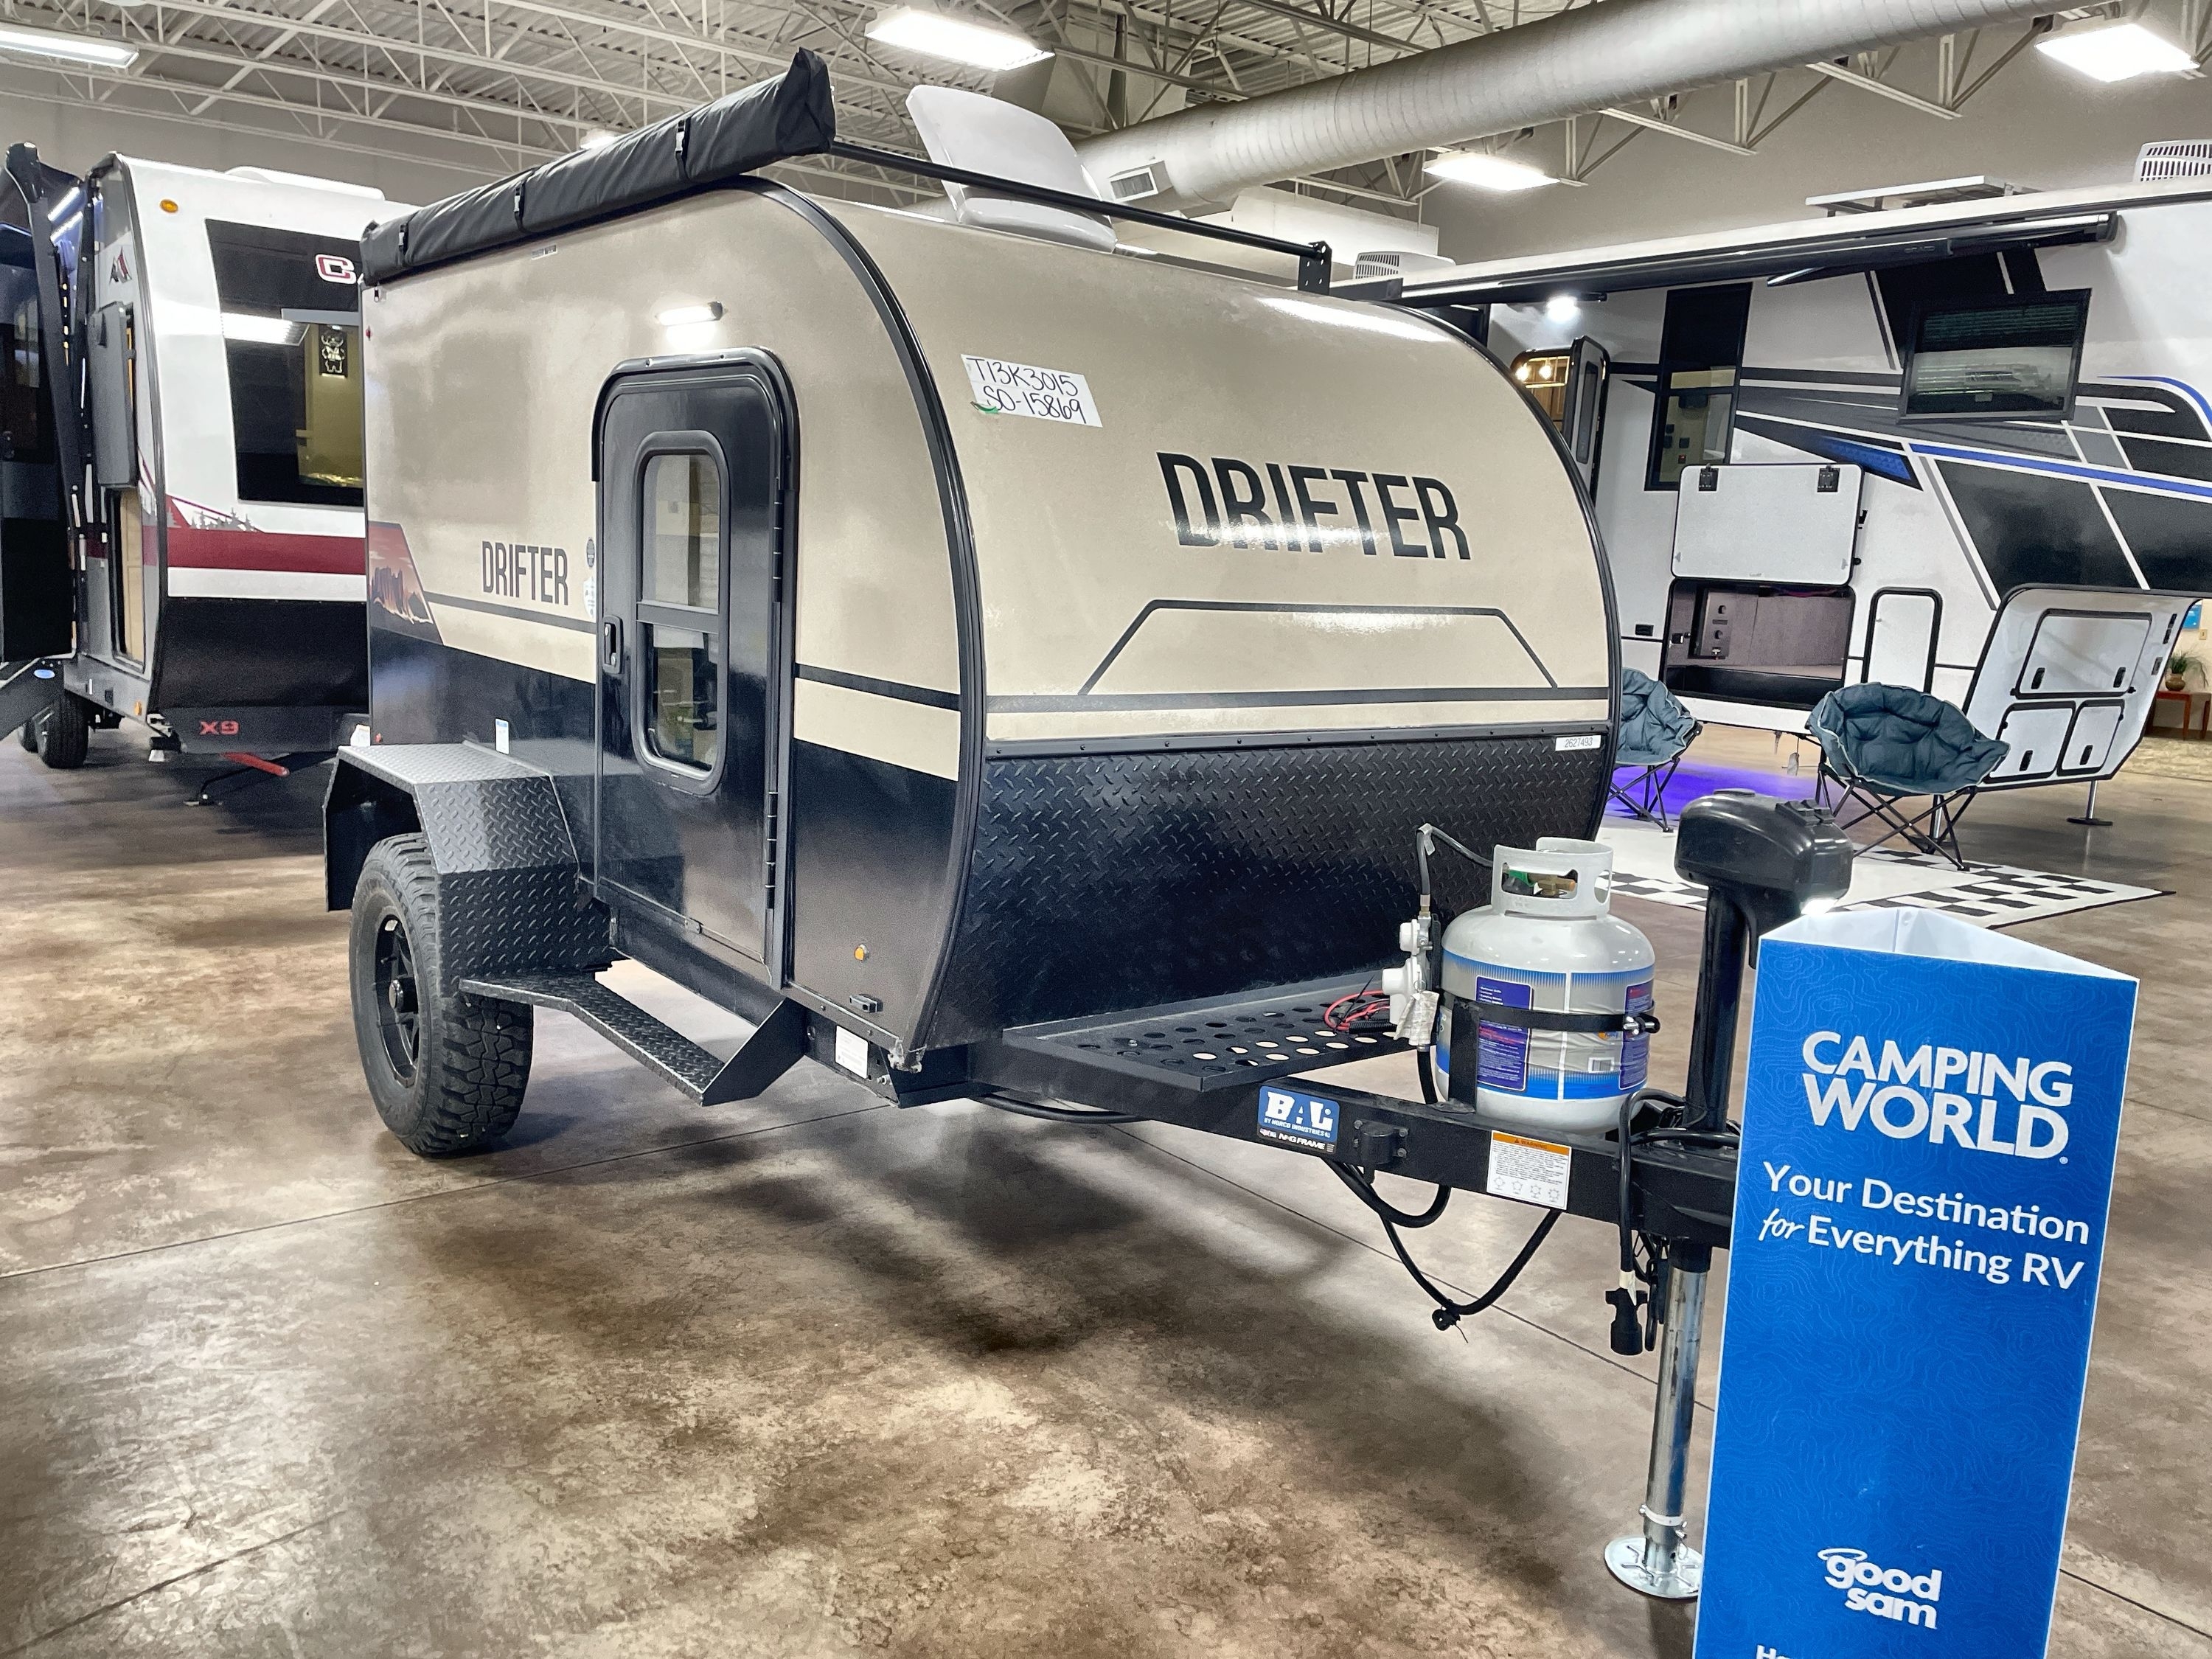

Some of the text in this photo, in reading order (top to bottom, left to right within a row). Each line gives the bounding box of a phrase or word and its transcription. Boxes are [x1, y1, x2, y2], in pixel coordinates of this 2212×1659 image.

[316, 254, 364, 285] C
[1156, 451, 1471, 560] DRIFTER
[481, 540, 569, 606] DRIFTER
[198, 720, 240, 735] X9
[1564, 737, 1593, 748] 2627493
[1802, 1031, 2073, 1107] CAMPING
[1291, 1123, 1325, 1138] INDUSTRIES
[1802, 1073, 2070, 1160] WORLD
[1297, 1137, 1326, 1150] FRAME
[1521, 1141, 1548, 1150] WARNING
[1763, 1161, 2089, 1245] Your Destination
[1758, 1208, 2085, 1290] for Everything RV
[1823, 1554, 1943, 1602] good
[1844, 1587, 1937, 1630] sam
